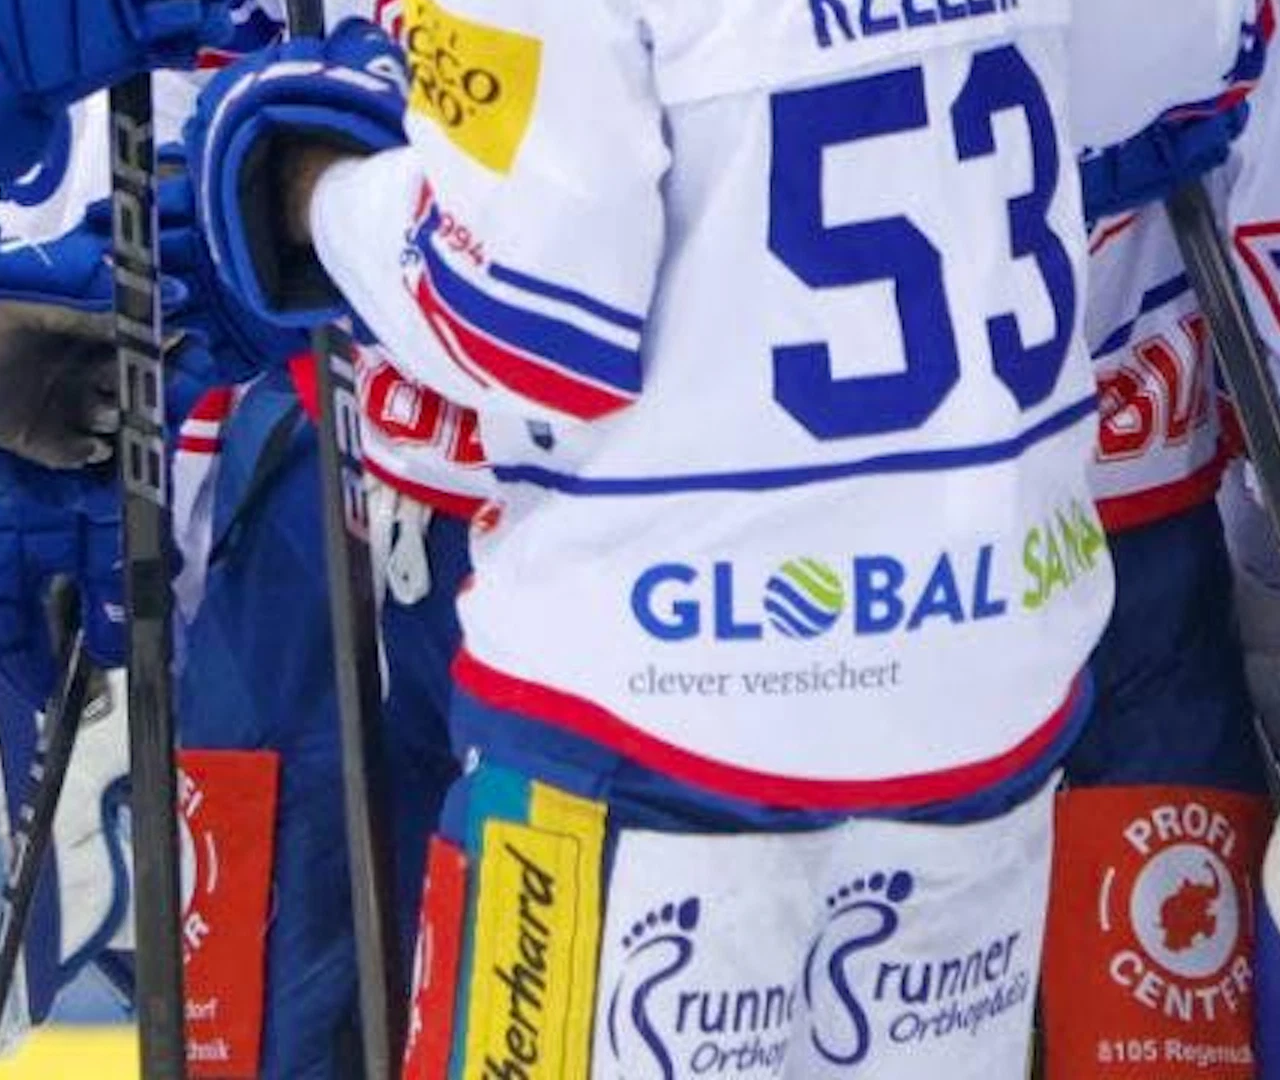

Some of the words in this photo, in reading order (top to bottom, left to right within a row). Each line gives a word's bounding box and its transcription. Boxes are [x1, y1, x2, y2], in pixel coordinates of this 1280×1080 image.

[438, 212, 485, 267] 994
[767, 41, 1078, 442] 53
[629, 544, 1008, 642] GLOBAL
[628, 661, 733, 696] clever
[740, 658, 903, 693] versichert
[1123, 802, 1237, 860] PROFI
[481, 842, 558, 1080] berhard
[872, 931, 1020, 1004] runner
[1108, 948, 1253, 1023] CENTER
[676, 983, 796, 1033] runn
[1096, 1038, 1158, 1063] 8105
